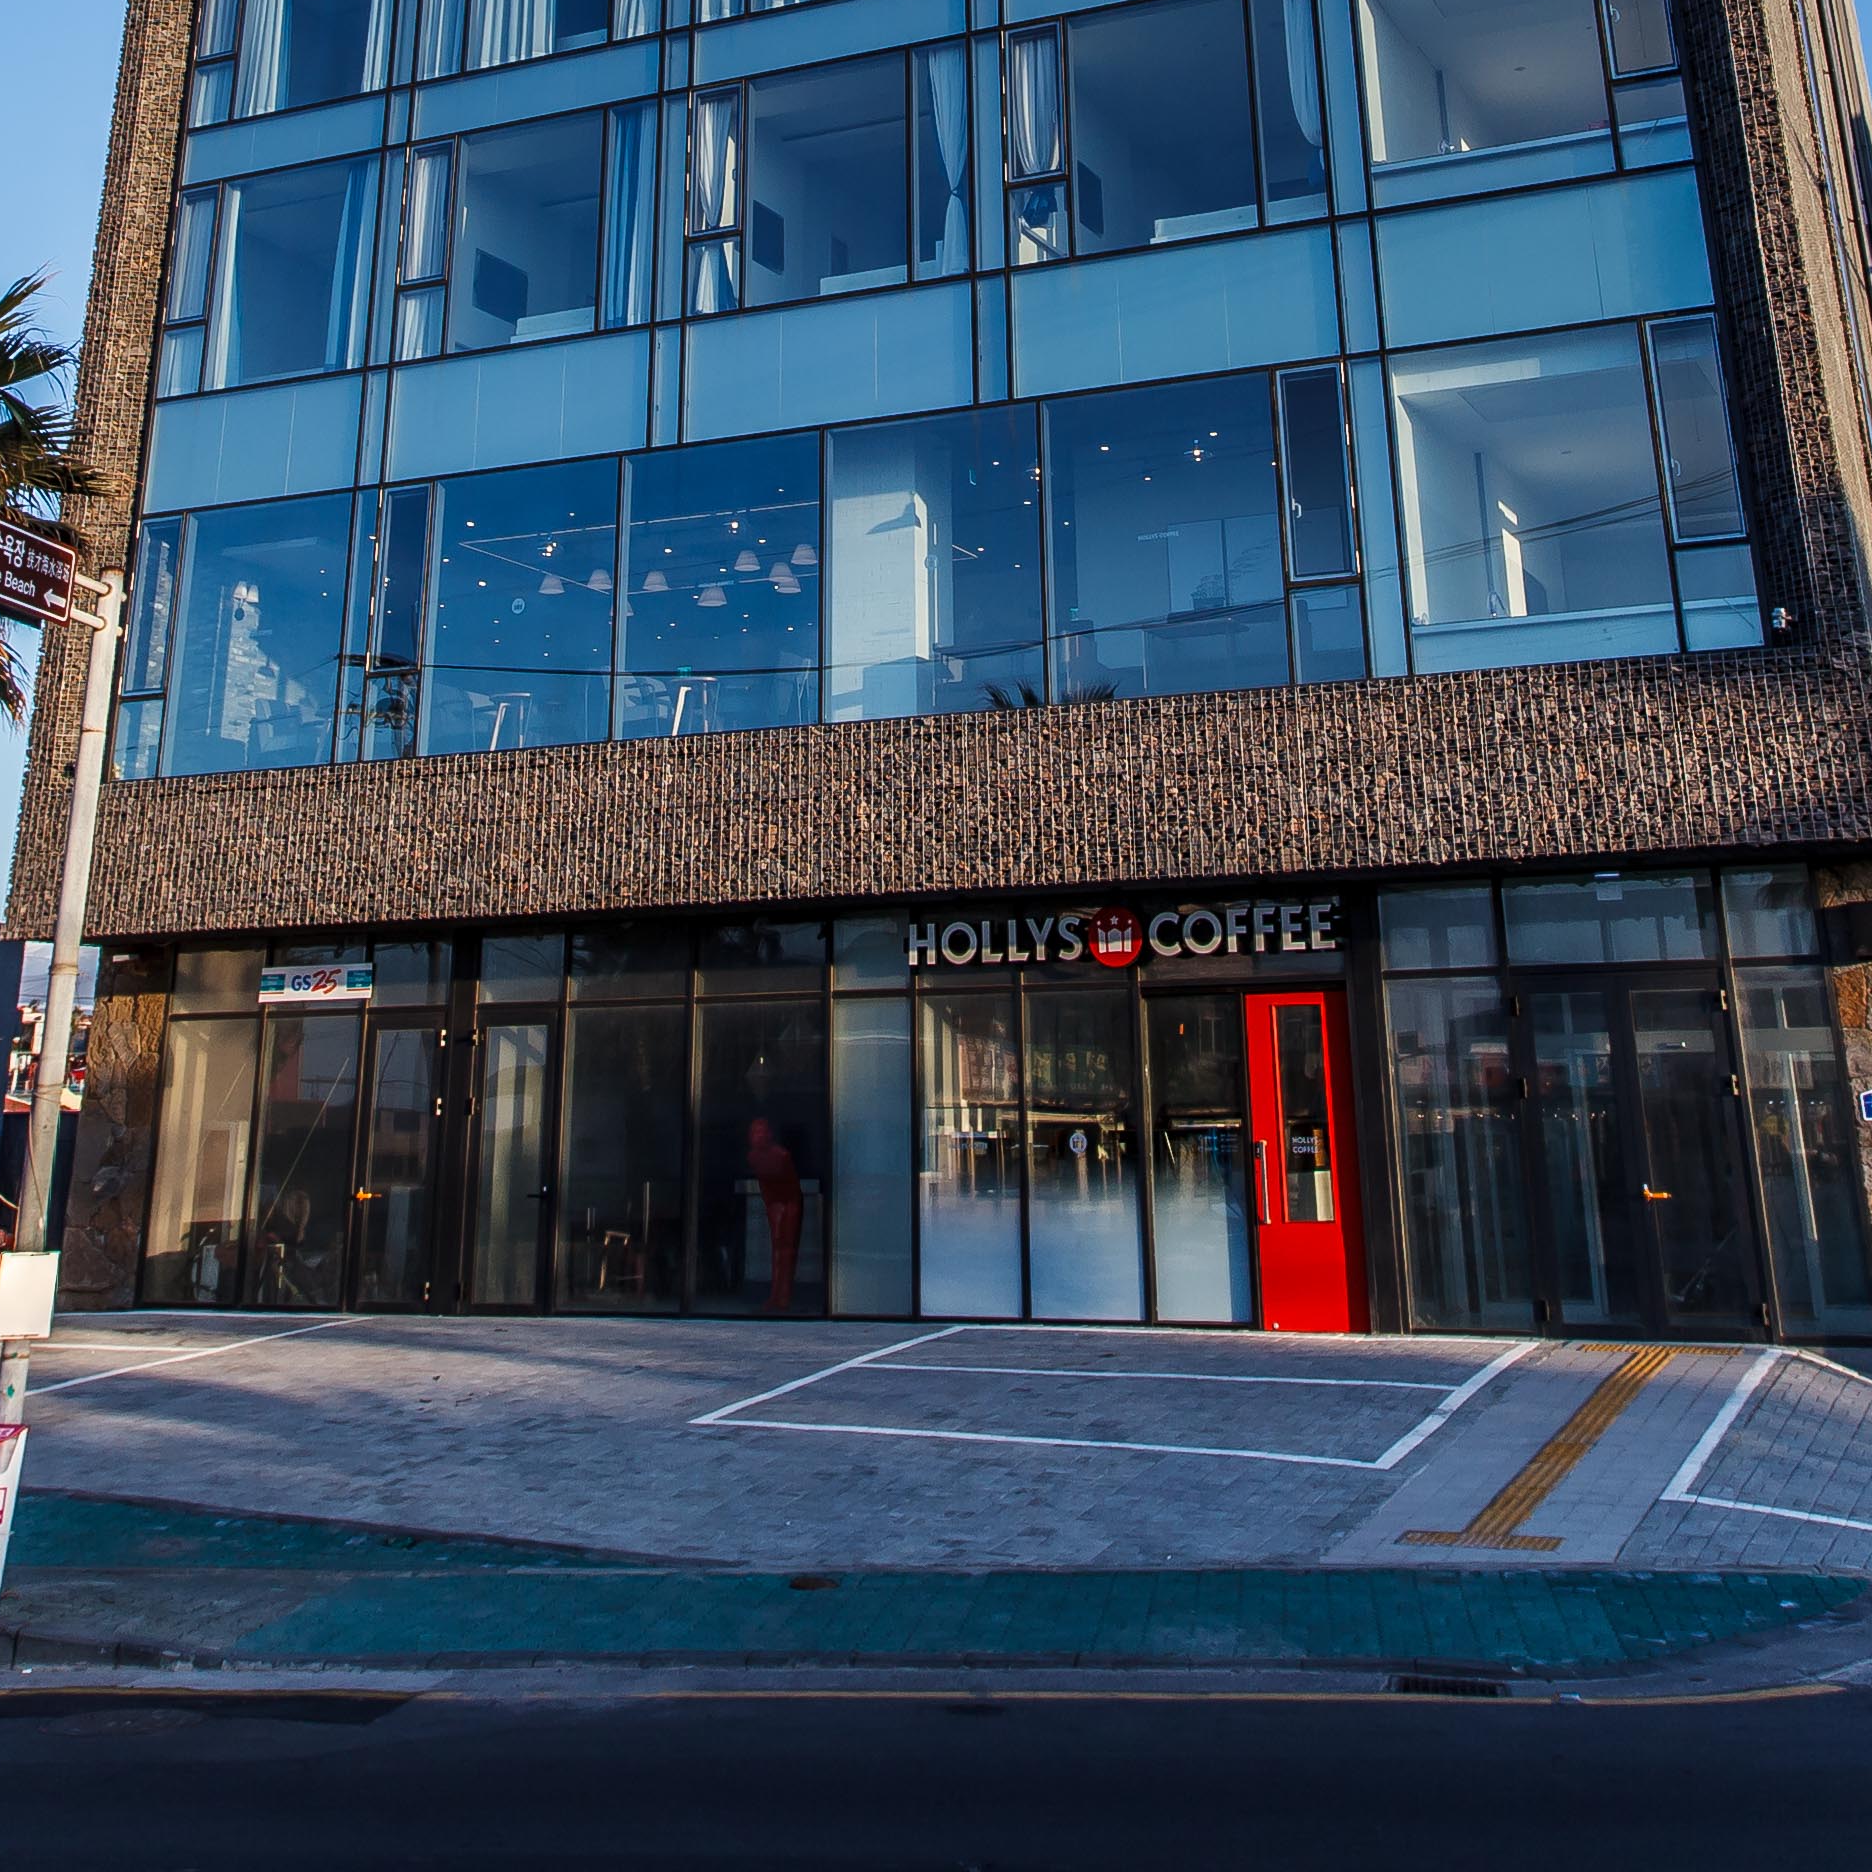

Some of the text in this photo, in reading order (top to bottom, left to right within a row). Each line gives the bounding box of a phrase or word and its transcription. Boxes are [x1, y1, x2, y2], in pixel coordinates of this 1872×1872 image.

[4, 570, 36, 597] Beach
[907, 903, 1336, 967] HOLLYS COFFEE
[290, 968, 343, 996] GS25
